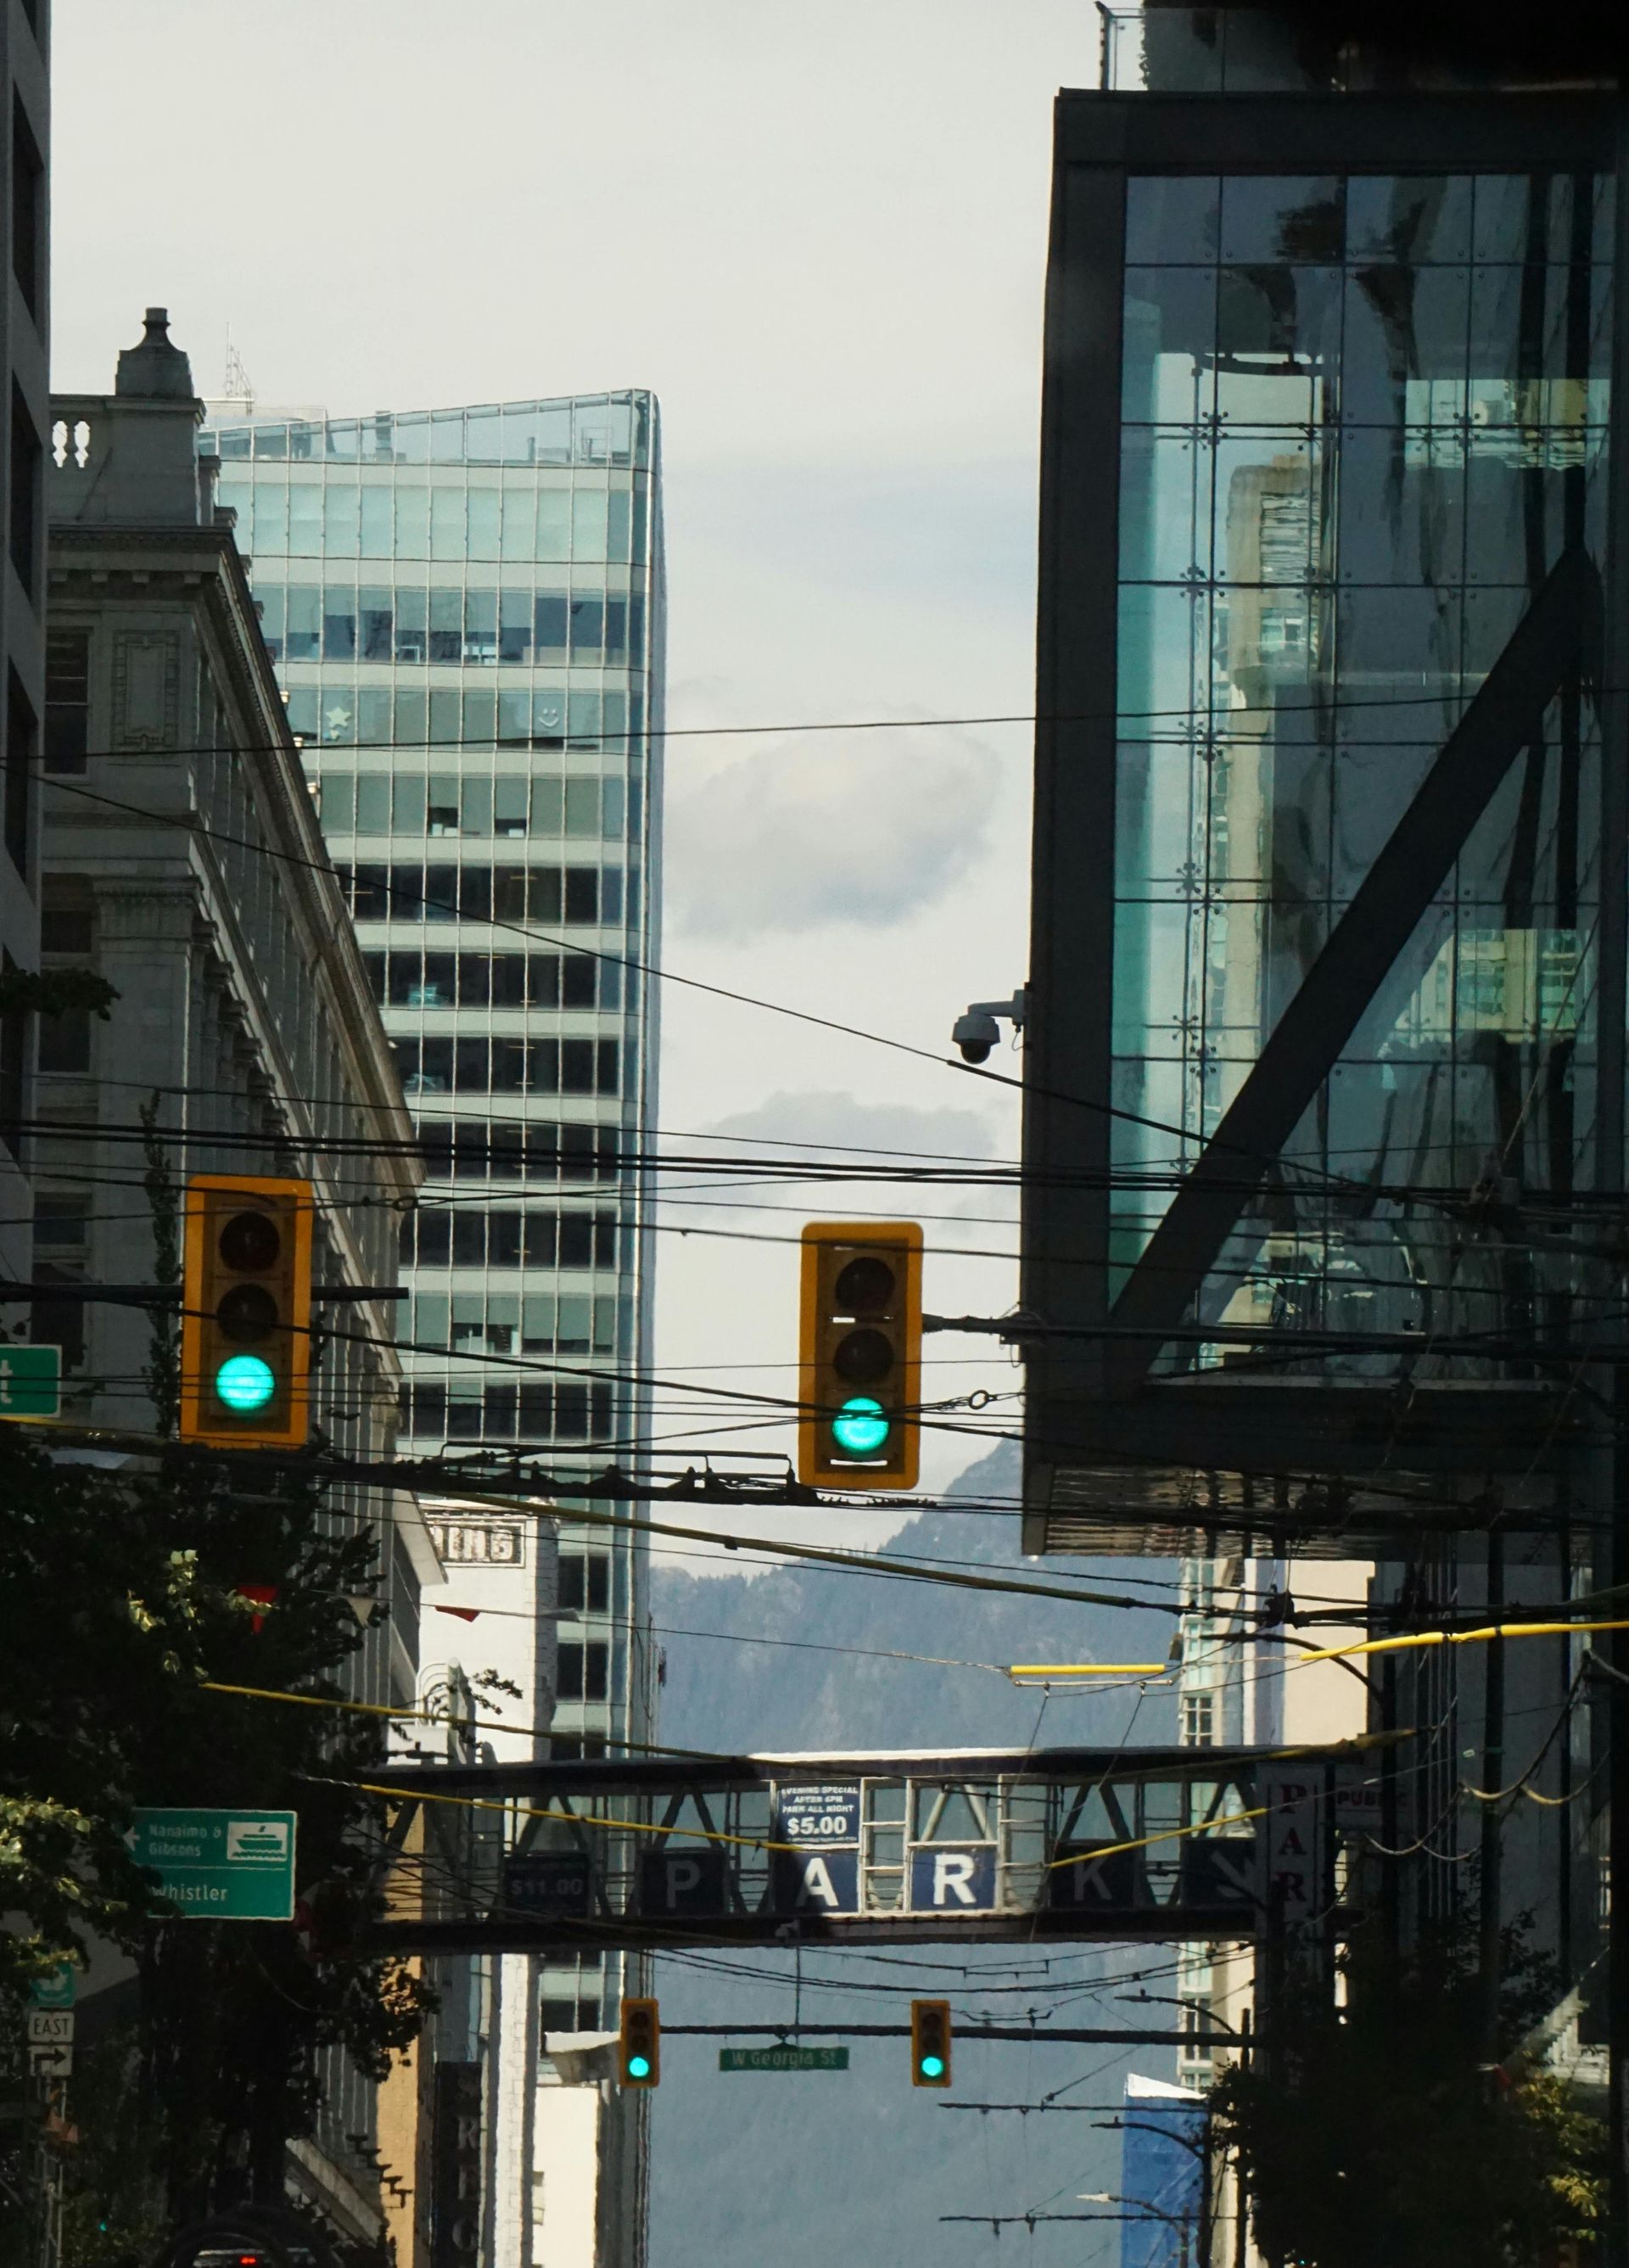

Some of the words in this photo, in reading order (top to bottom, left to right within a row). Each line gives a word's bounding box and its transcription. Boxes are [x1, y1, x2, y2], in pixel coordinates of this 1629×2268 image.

[821, 1785, 859, 1795] SPECIAL
[781, 1805, 806, 1814] PARK
[807, 1805, 825, 1813] ALL
[826, 1804, 854, 1812] NIGHT
[148, 1823, 208, 1839] Nanaimo
[787, 1815, 848, 1836] $5.00
[148, 1842, 202, 1857] Gibsons
[509, 1876, 585, 1897] $11.00
[33, 2017, 70, 2036] EAST
[731, 2051, 747, 2066] W
[751, 2050, 814, 2070] Georgia
[820, 2049, 837, 2066] St
